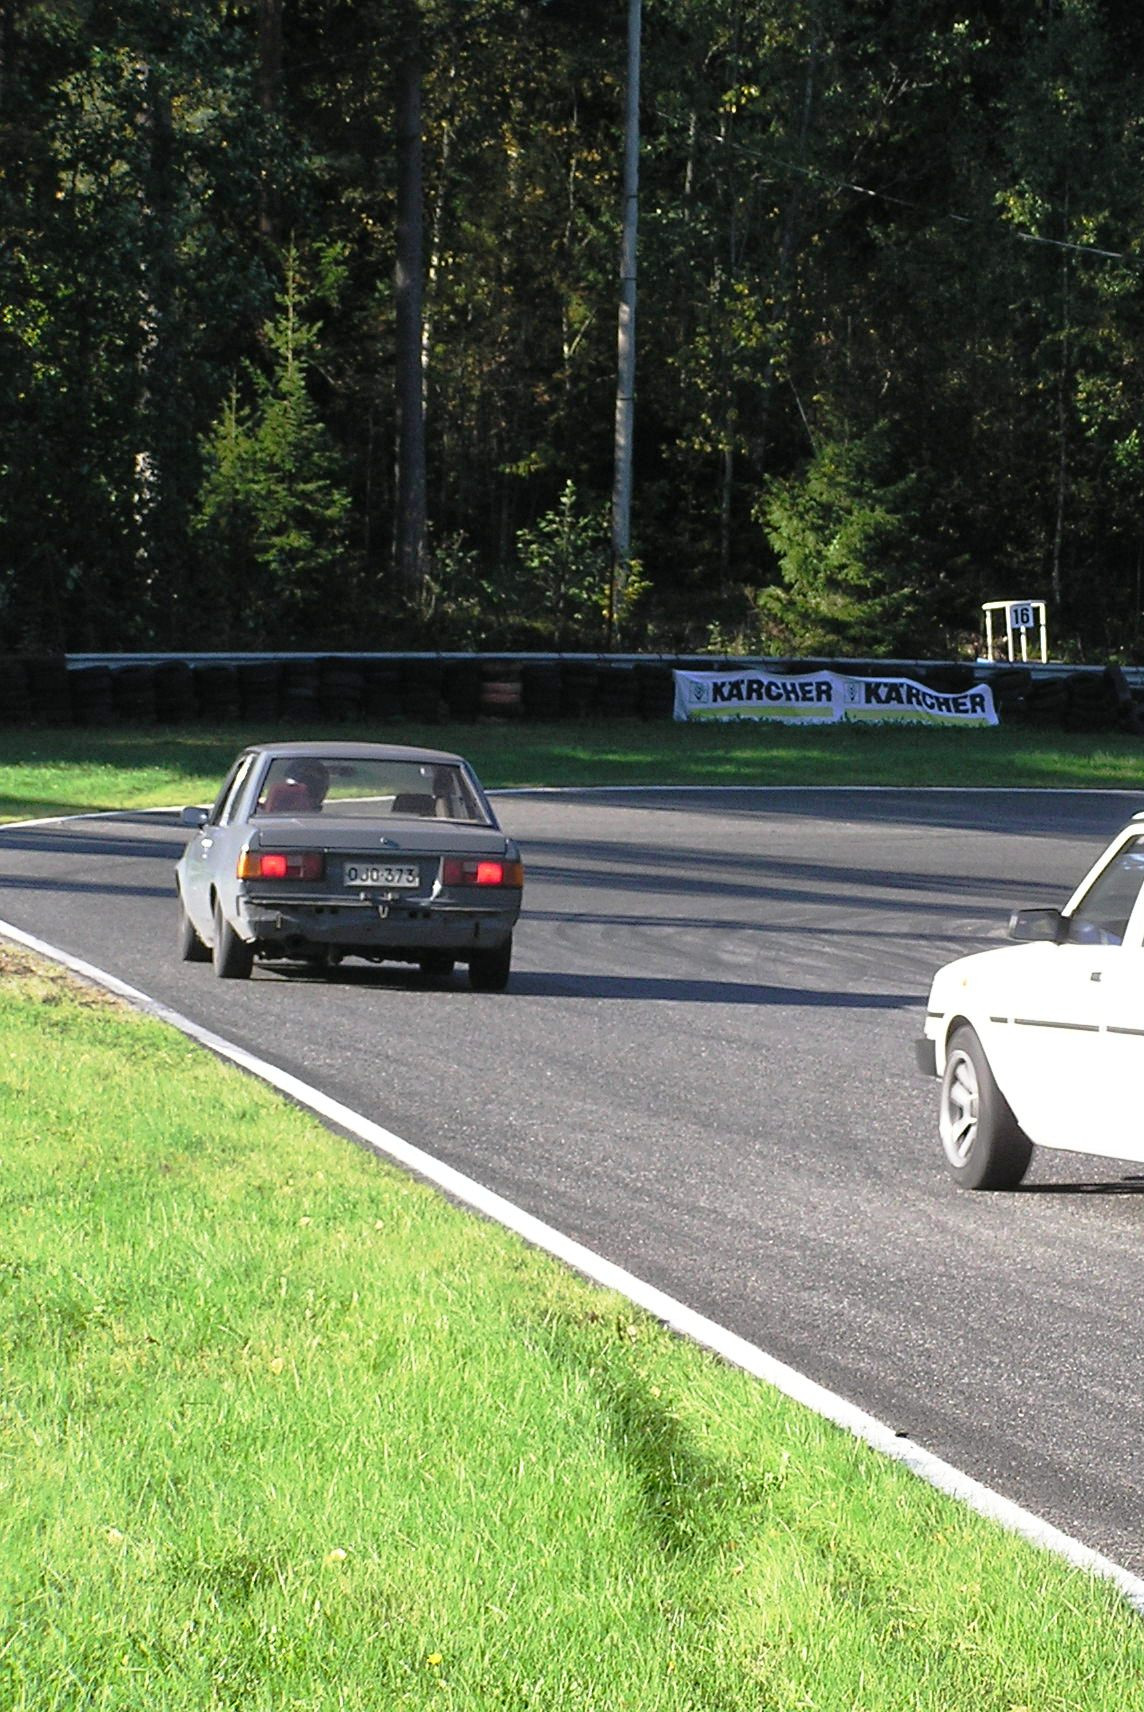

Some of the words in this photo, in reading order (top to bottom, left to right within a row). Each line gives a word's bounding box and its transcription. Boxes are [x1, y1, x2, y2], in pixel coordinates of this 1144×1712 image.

[1013, 607, 1030, 625] 16
[711, 679, 833, 703] KÄRCHER
[864, 681, 986, 714] KÄRCHER
